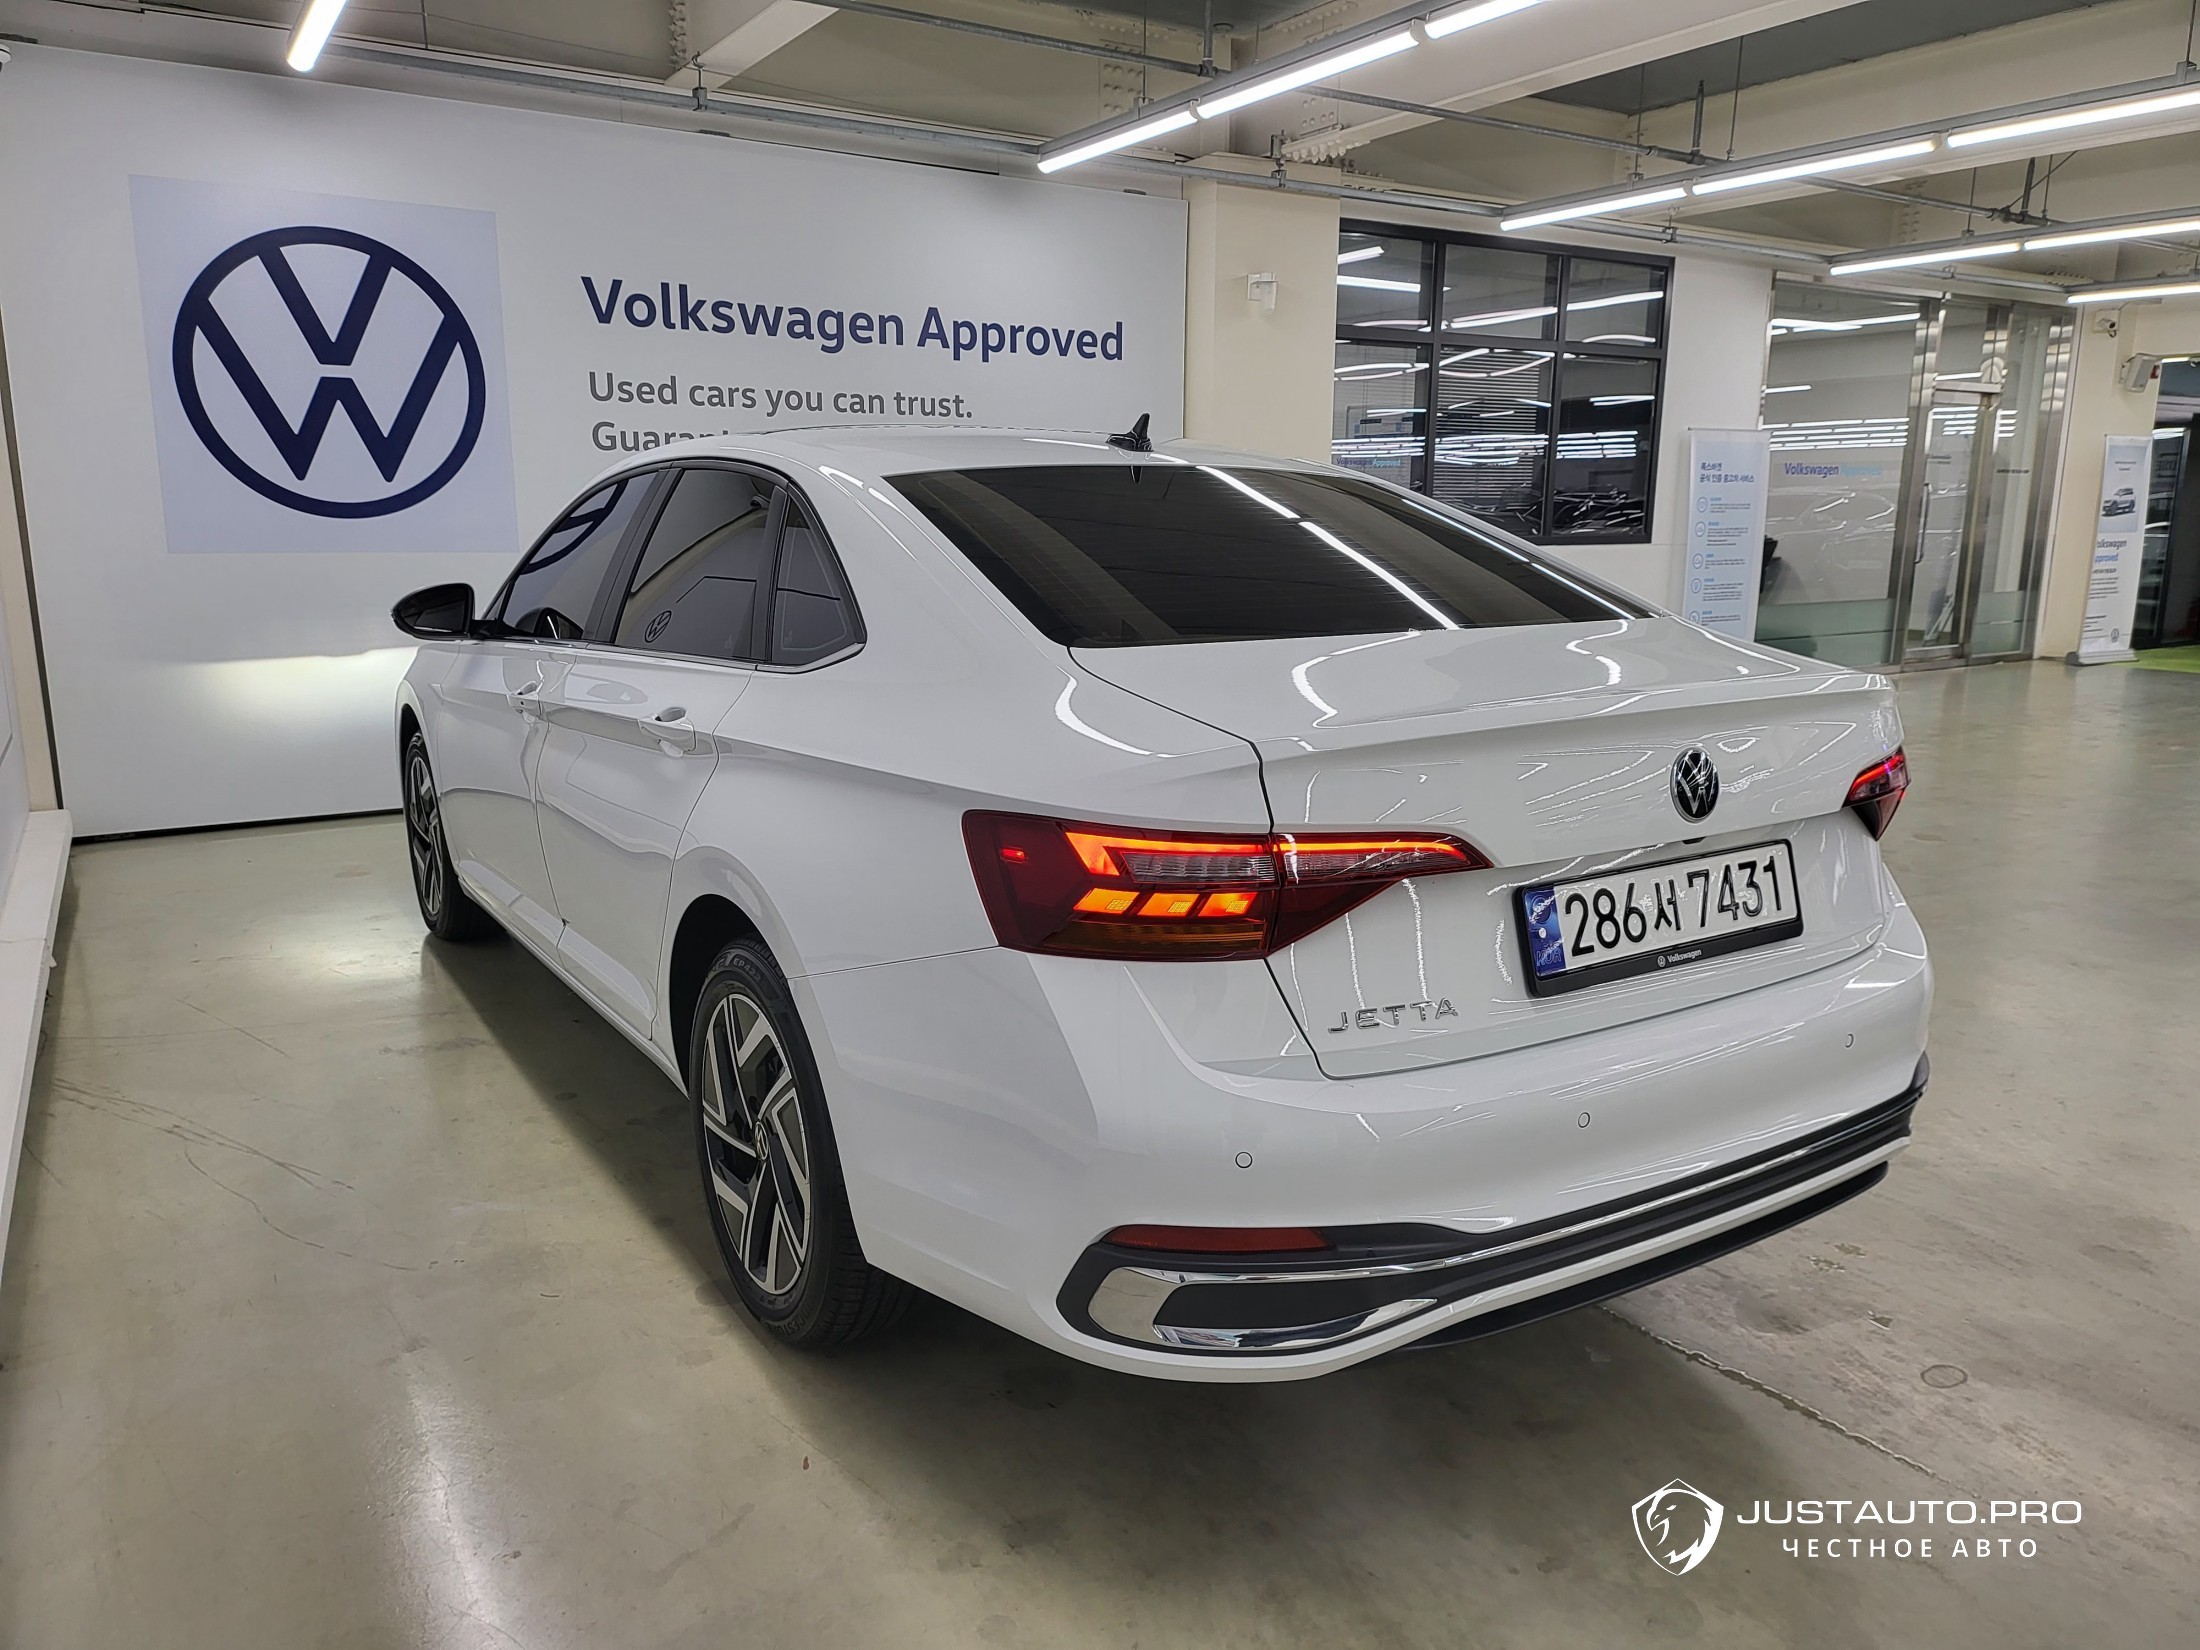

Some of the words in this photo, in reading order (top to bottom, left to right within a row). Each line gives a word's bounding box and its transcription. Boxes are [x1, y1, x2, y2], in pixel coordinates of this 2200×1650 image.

[580, 275, 904, 354] Volkswagen
[916, 306, 1124, 363] Approved
[588, 371, 678, 405] Used
[688, 384, 757, 409] cars
[764, 389, 823, 418] you
[833, 392, 885, 415] can
[893, 391, 973, 419] trust.
[1785, 462, 1839, 478] Volkswagen
[1667, 949, 1702, 962] Volkswagen
[1328, 997, 1459, 1034] JETTA
